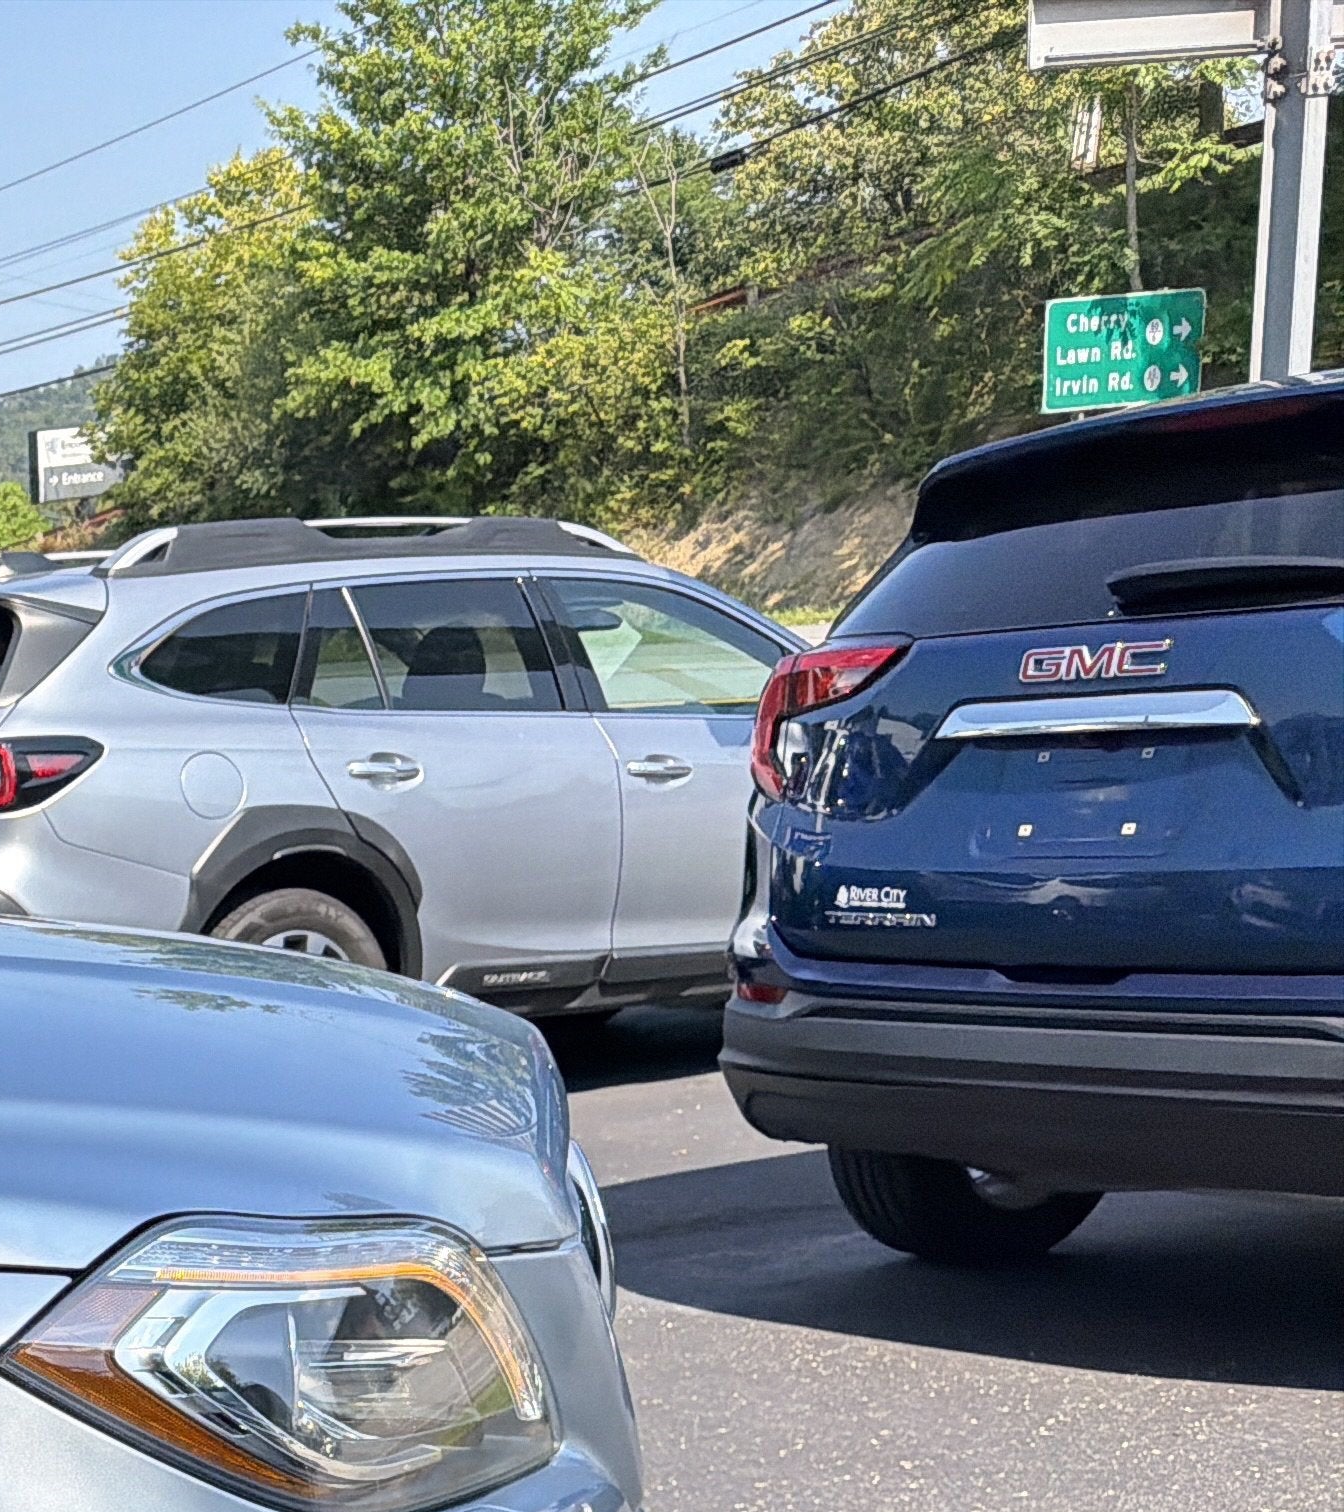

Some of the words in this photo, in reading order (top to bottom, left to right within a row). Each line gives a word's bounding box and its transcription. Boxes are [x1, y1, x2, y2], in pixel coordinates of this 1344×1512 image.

[1067, 311, 1130, 333] Cherry
[1056, 346, 1101, 366] Lawn
[1110, 339, 1137, 361] Rd.
[1055, 374, 1099, 397] Irvin
[1107, 371, 1134, 393] Rd.
[61, 471, 104, 486] Entrance
[1019, 641, 1172, 683] GMC
[849, 885, 879, 902] RIVER
[880, 886, 908, 903] CITY
